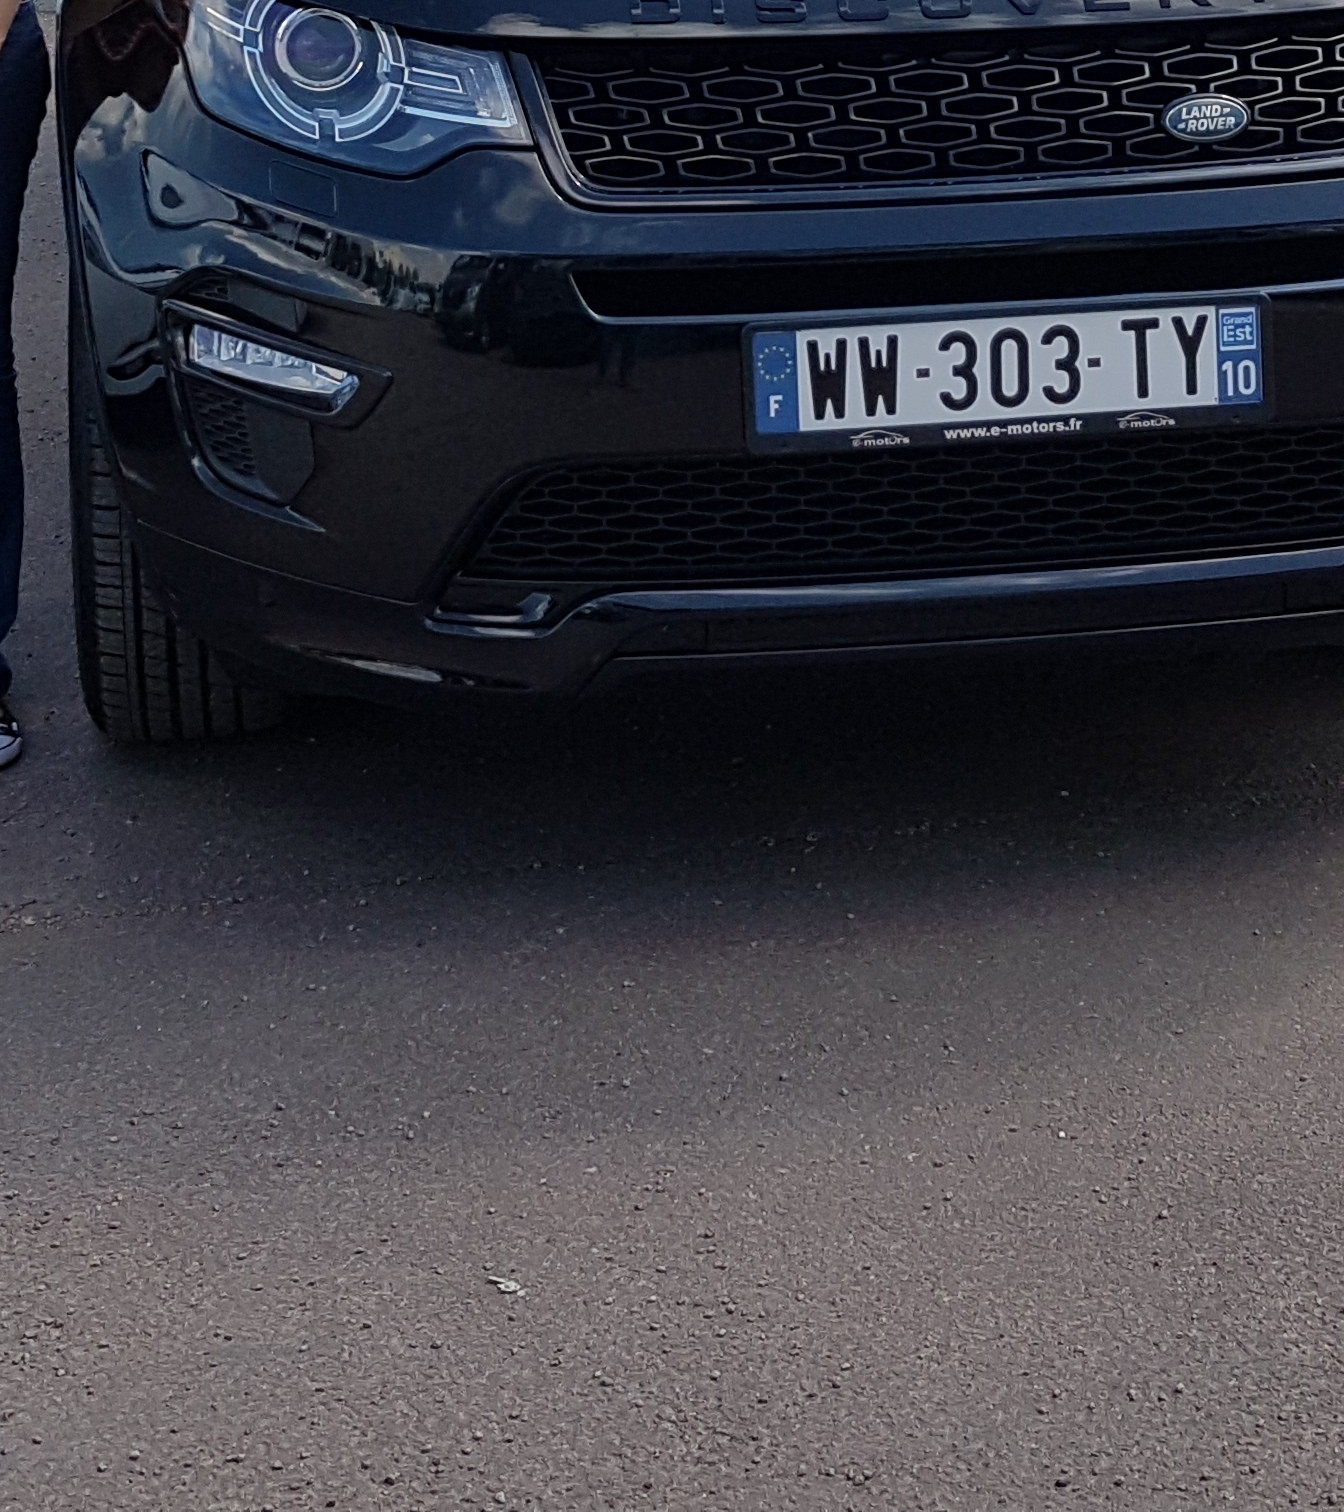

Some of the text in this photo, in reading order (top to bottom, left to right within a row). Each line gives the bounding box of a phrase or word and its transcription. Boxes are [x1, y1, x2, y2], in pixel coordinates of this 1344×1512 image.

[1181, 104, 1221, 119] LAND
[1186, 116, 1236, 132] ROVER
[1223, 314, 1253, 325] Grand
[1223, 325, 1253, 342] Est
[769, 314, 1209, 421] F WW-303-TY
[1221, 359, 1256, 396] 10
[944, 418, 1084, 441] www.e-motors.fr
